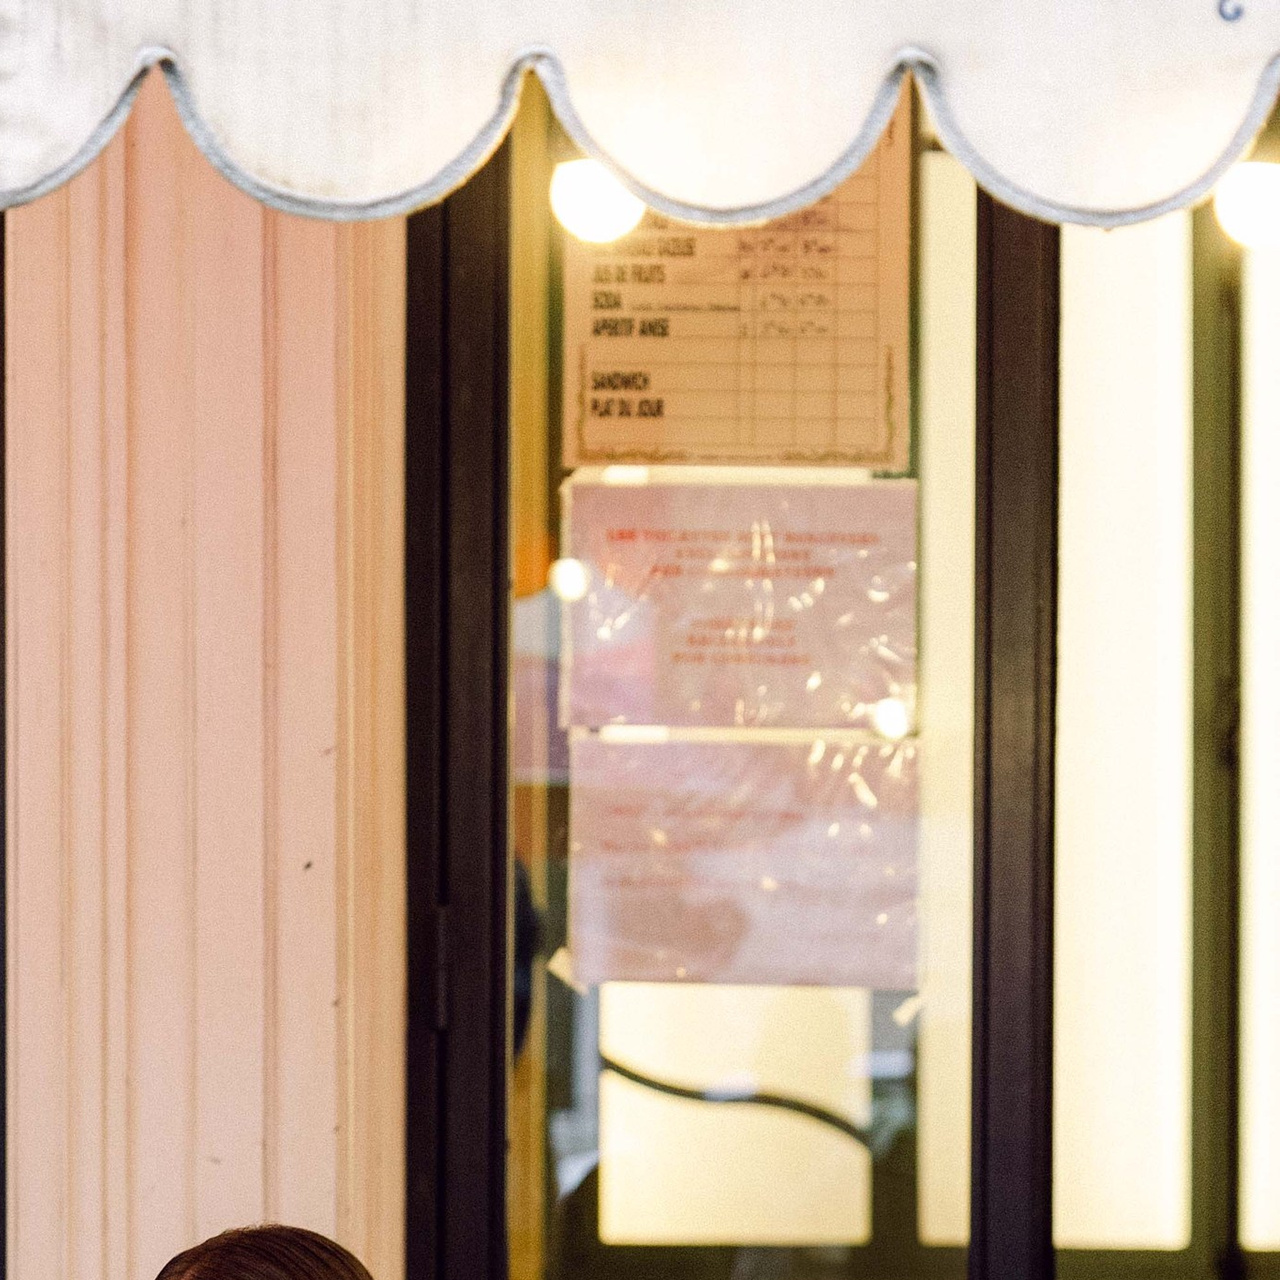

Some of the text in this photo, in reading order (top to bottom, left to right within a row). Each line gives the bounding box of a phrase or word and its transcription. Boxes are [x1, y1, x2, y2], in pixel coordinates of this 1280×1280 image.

[591, 370, 651, 391] SANDWICH
[592, 397, 664, 418] PLAT DU JOUR
